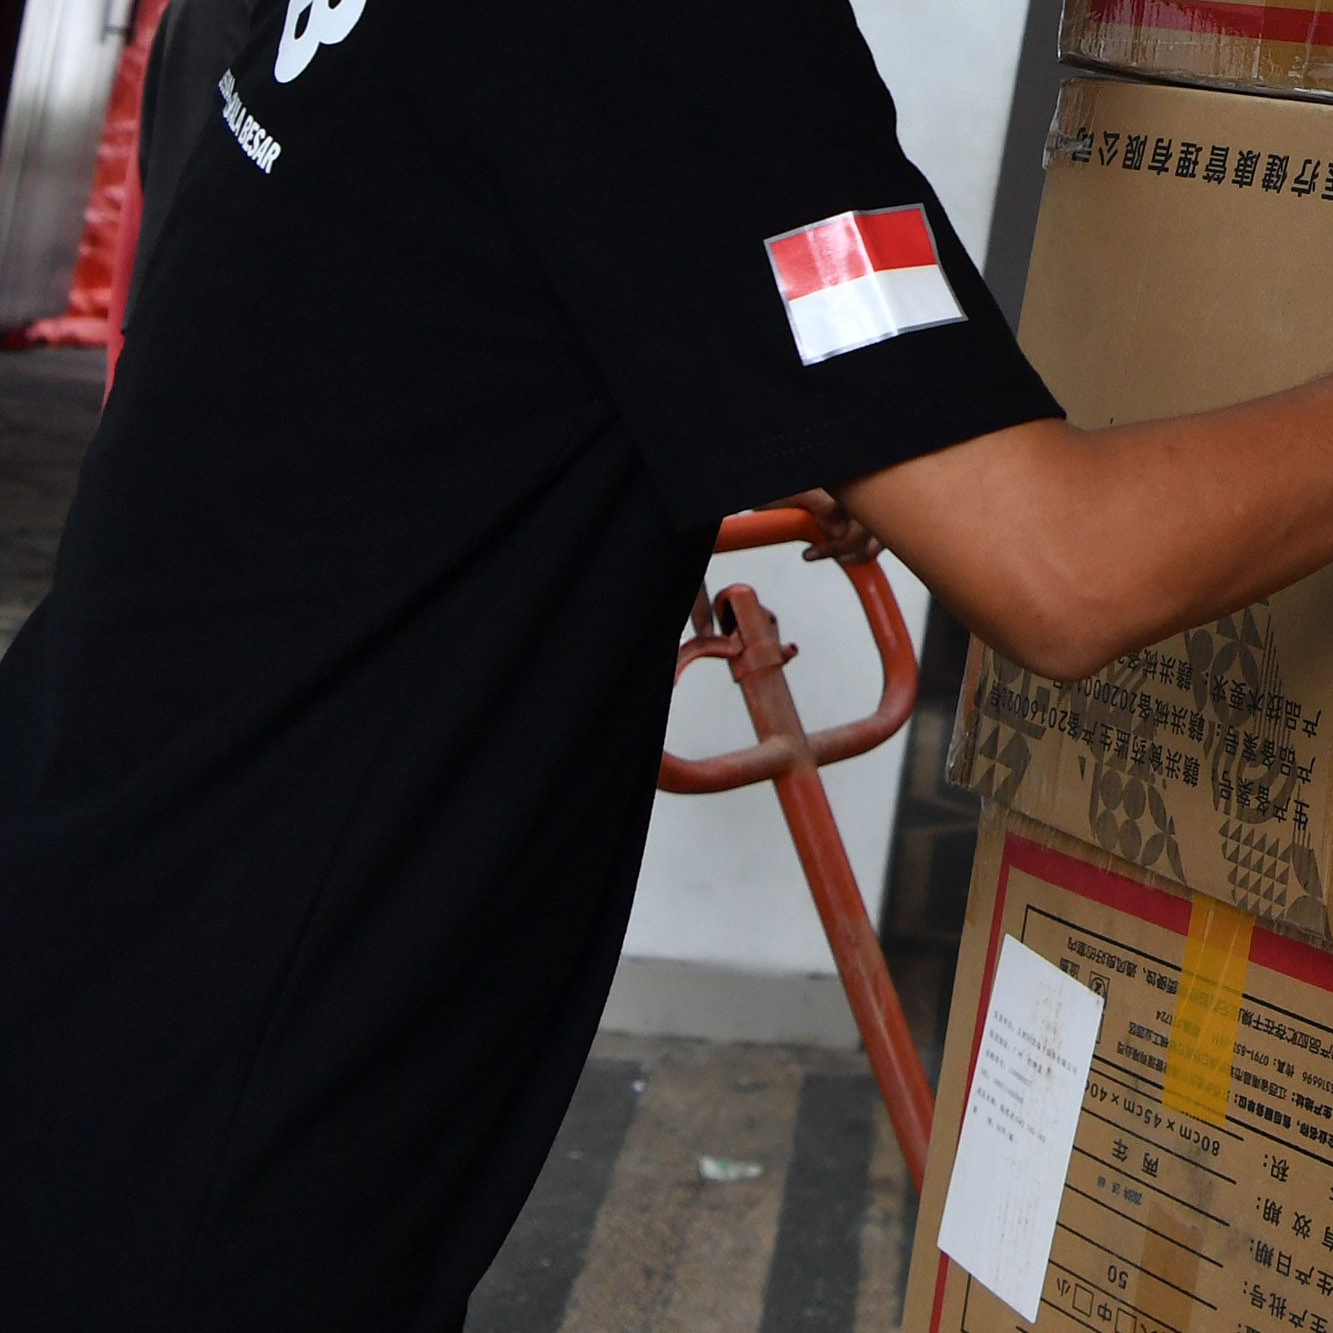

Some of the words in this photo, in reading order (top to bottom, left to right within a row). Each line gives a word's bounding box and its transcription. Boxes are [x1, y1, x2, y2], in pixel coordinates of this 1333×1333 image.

[239, 113, 283, 175] BESAR
[1121, 1096, 1163, 1129] 45cm
[1177, 1123, 1221, 1156] 80cm
[1107, 1265, 1128, 1287] 50
